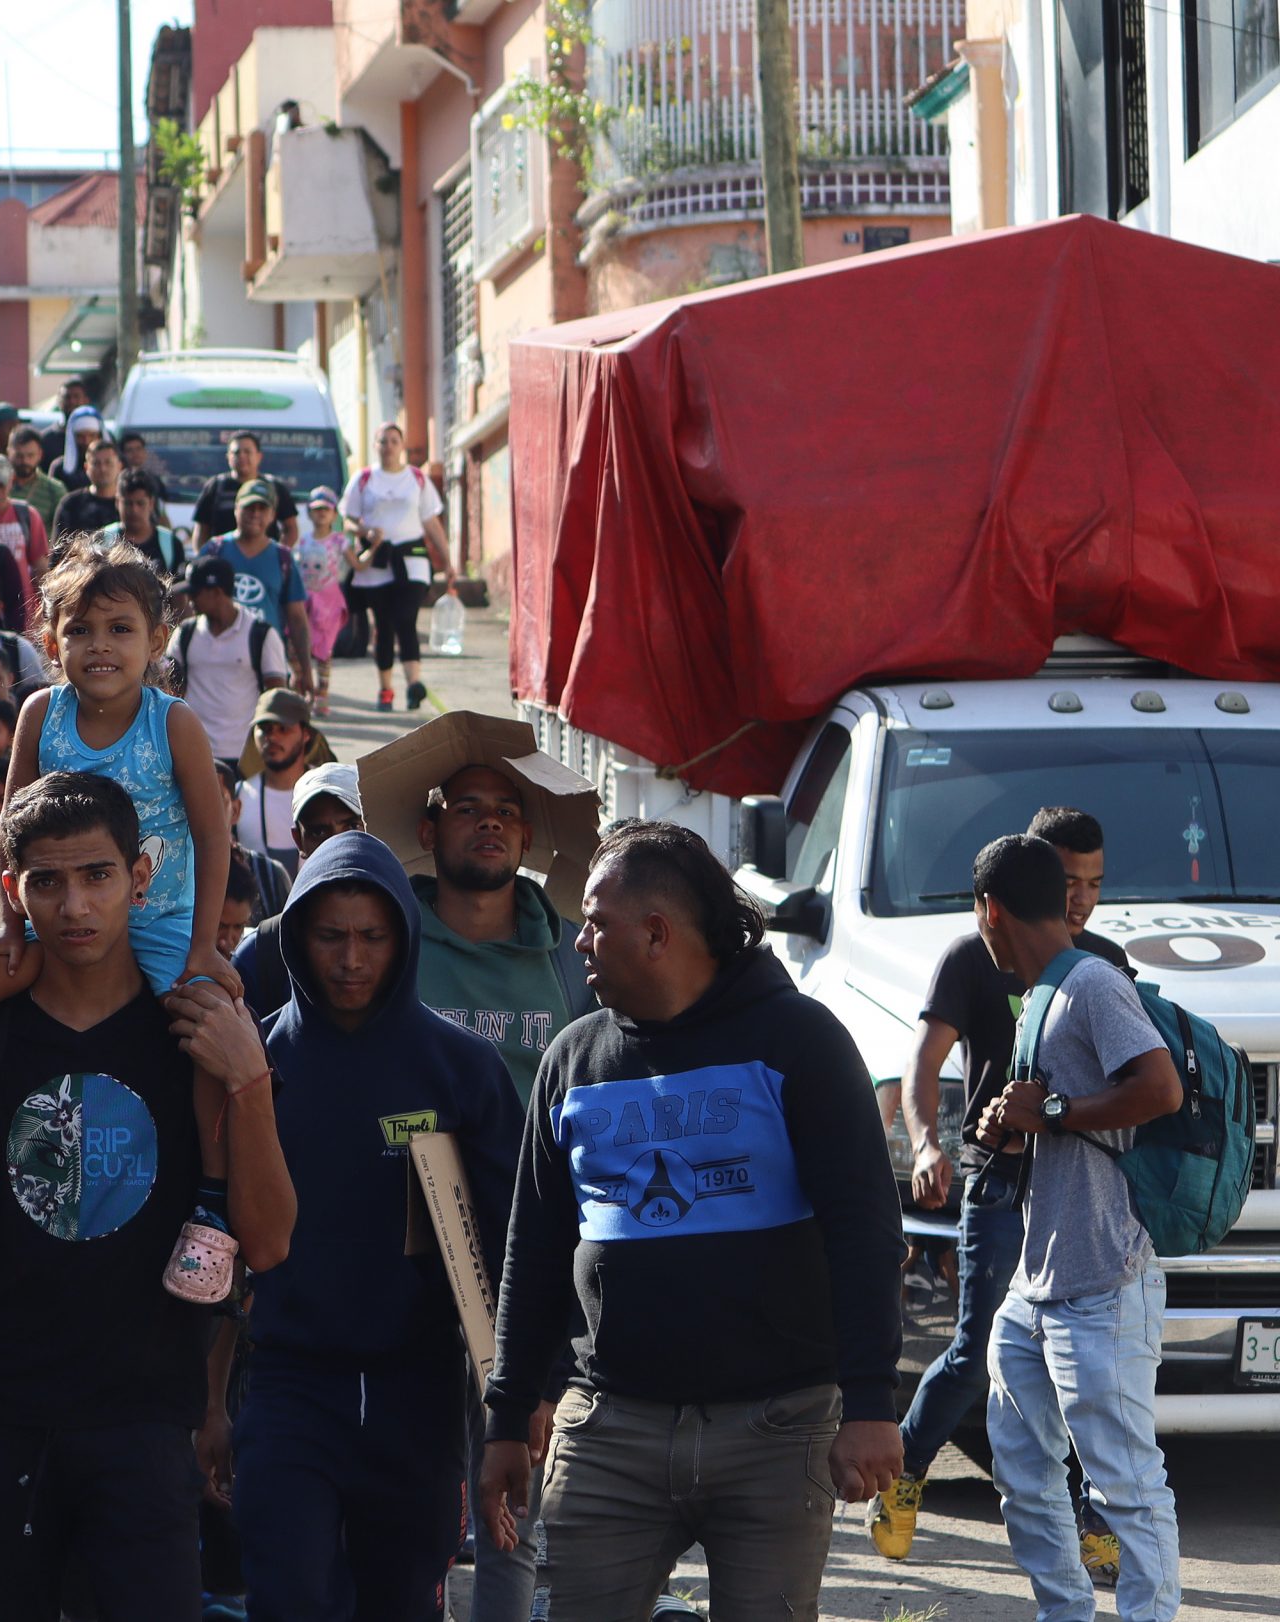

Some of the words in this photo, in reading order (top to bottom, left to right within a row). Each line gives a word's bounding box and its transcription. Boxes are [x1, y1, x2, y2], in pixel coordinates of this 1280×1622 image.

[521, 1011, 552, 1052] IT
[387, 1117, 430, 1141] Tripoli
[574, 1088, 742, 1154] PARIS
[86, 1127, 131, 1153] RIP
[83, 1153, 151, 1178] CURL
[701, 1167, 749, 1188] 1970
[426, 1174, 435, 1188] 12
[430, 1189, 445, 1225] PAQUETES
[441, 1226, 449, 1242] CON
[445, 1241, 455, 1262] 360
[452, 1264, 467, 1308] SERVILLETAS
